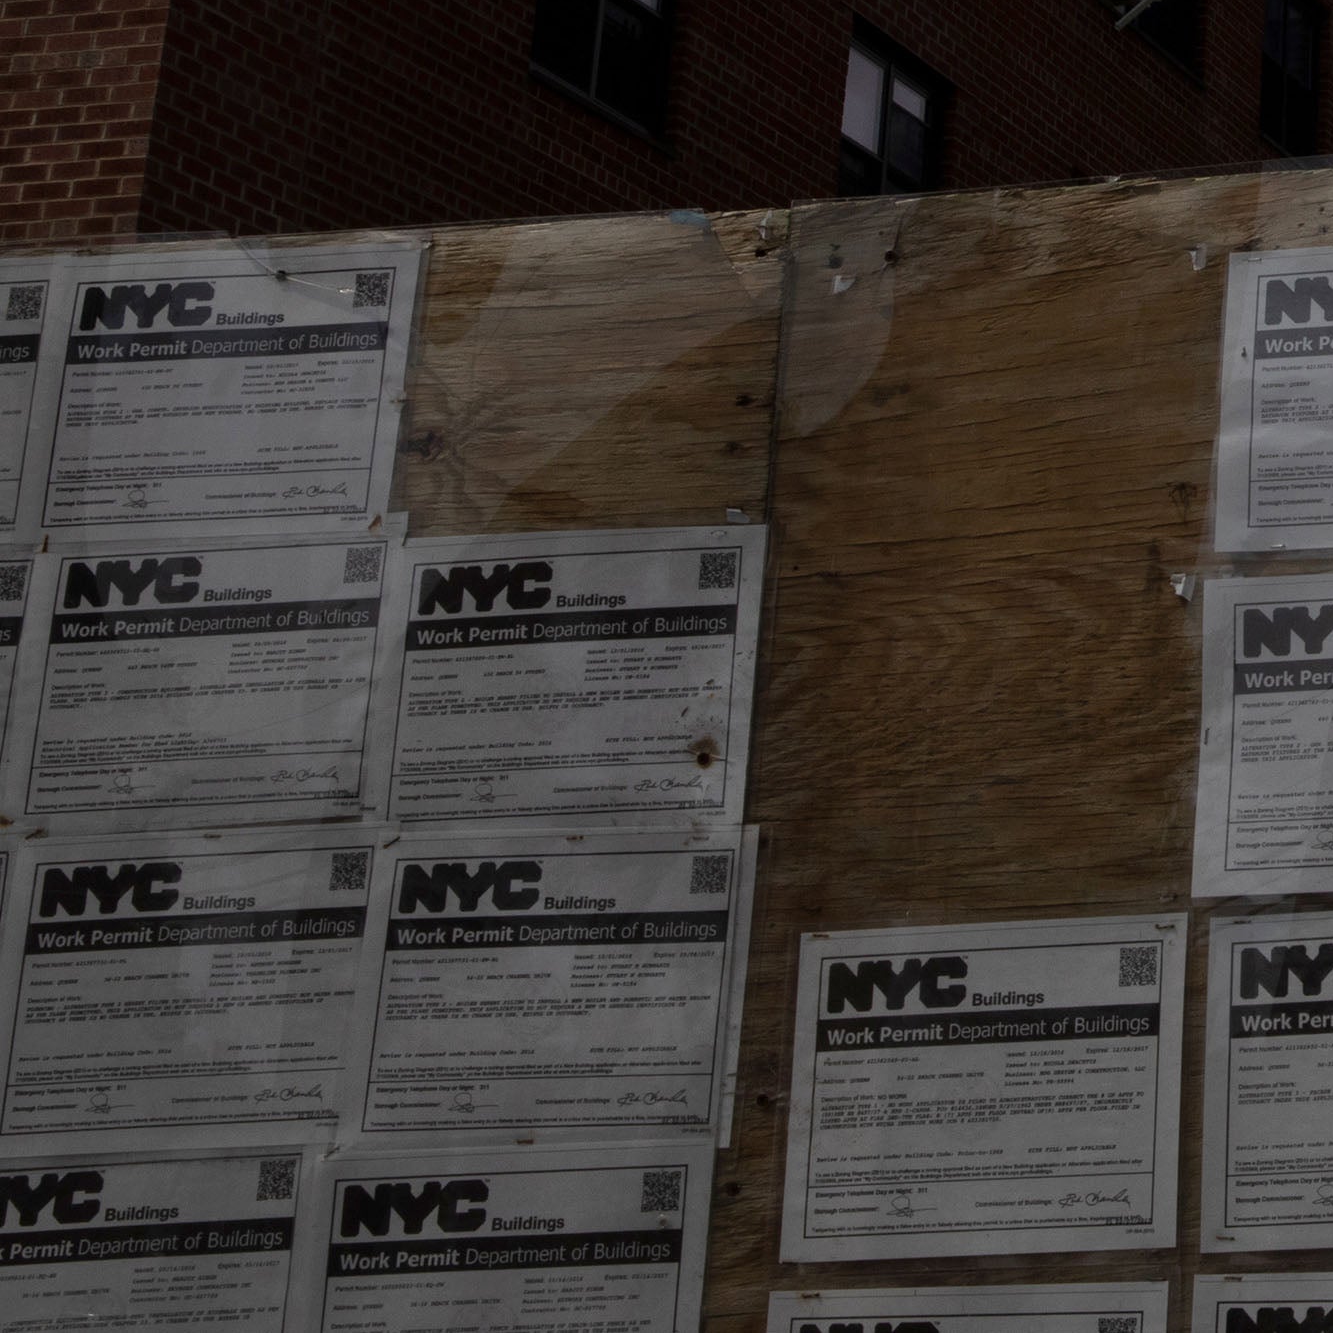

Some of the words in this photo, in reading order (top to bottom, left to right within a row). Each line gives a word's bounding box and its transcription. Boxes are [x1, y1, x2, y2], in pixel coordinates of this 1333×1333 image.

[79, 282, 213, 330] NYC
[216, 313, 283, 324] Buildings
[78, 343, 123, 358] Work
[130, 341, 187, 356] Permit
[192, 337, 283, 355] Department
[289, 334, 304, 349] of
[309, 332, 377, 348] Buildings
[418, 561, 552, 614] NYC
[556, 594, 625, 607] Buildings
[417, 628, 462, 644] Work
[469, 625, 527, 641] Permit
[533, 620, 626, 640] Department
[632, 618, 649, 633] of
[655, 615, 726, 633] Buildings
[1245, 671, 1293, 687] Work
[39, 862, 181, 917] NYC
[183, 896, 254, 910] Buildings
[38, 930, 84, 947] Work
[91, 928, 152, 944] Permit
[158, 923, 255, 942] Department
[261, 920, 277, 936] of
[282, 918, 354, 936] Buildings
[827, 956, 967, 1013] NYC
[972, 991, 1043, 1006] Buildings
[828, 1027, 873, 1044] Work
[880, 1025, 943, 1041] Permit
[949, 1020, 1046, 1041] Department
[1052, 1017, 1068, 1034] of
[1075, 1015, 1148, 1034] Buildings
[340, 1179, 488, 1237] NYC
[492, 1216, 563, 1231] Buildings
[340, 1252, 389, 1269] Work
[396, 1249, 459, 1267] Permit
[466, 1245, 566, 1267] Department
[571, 1243, 588, 1259] of
[594, 1241, 670, 1260] Buildings
